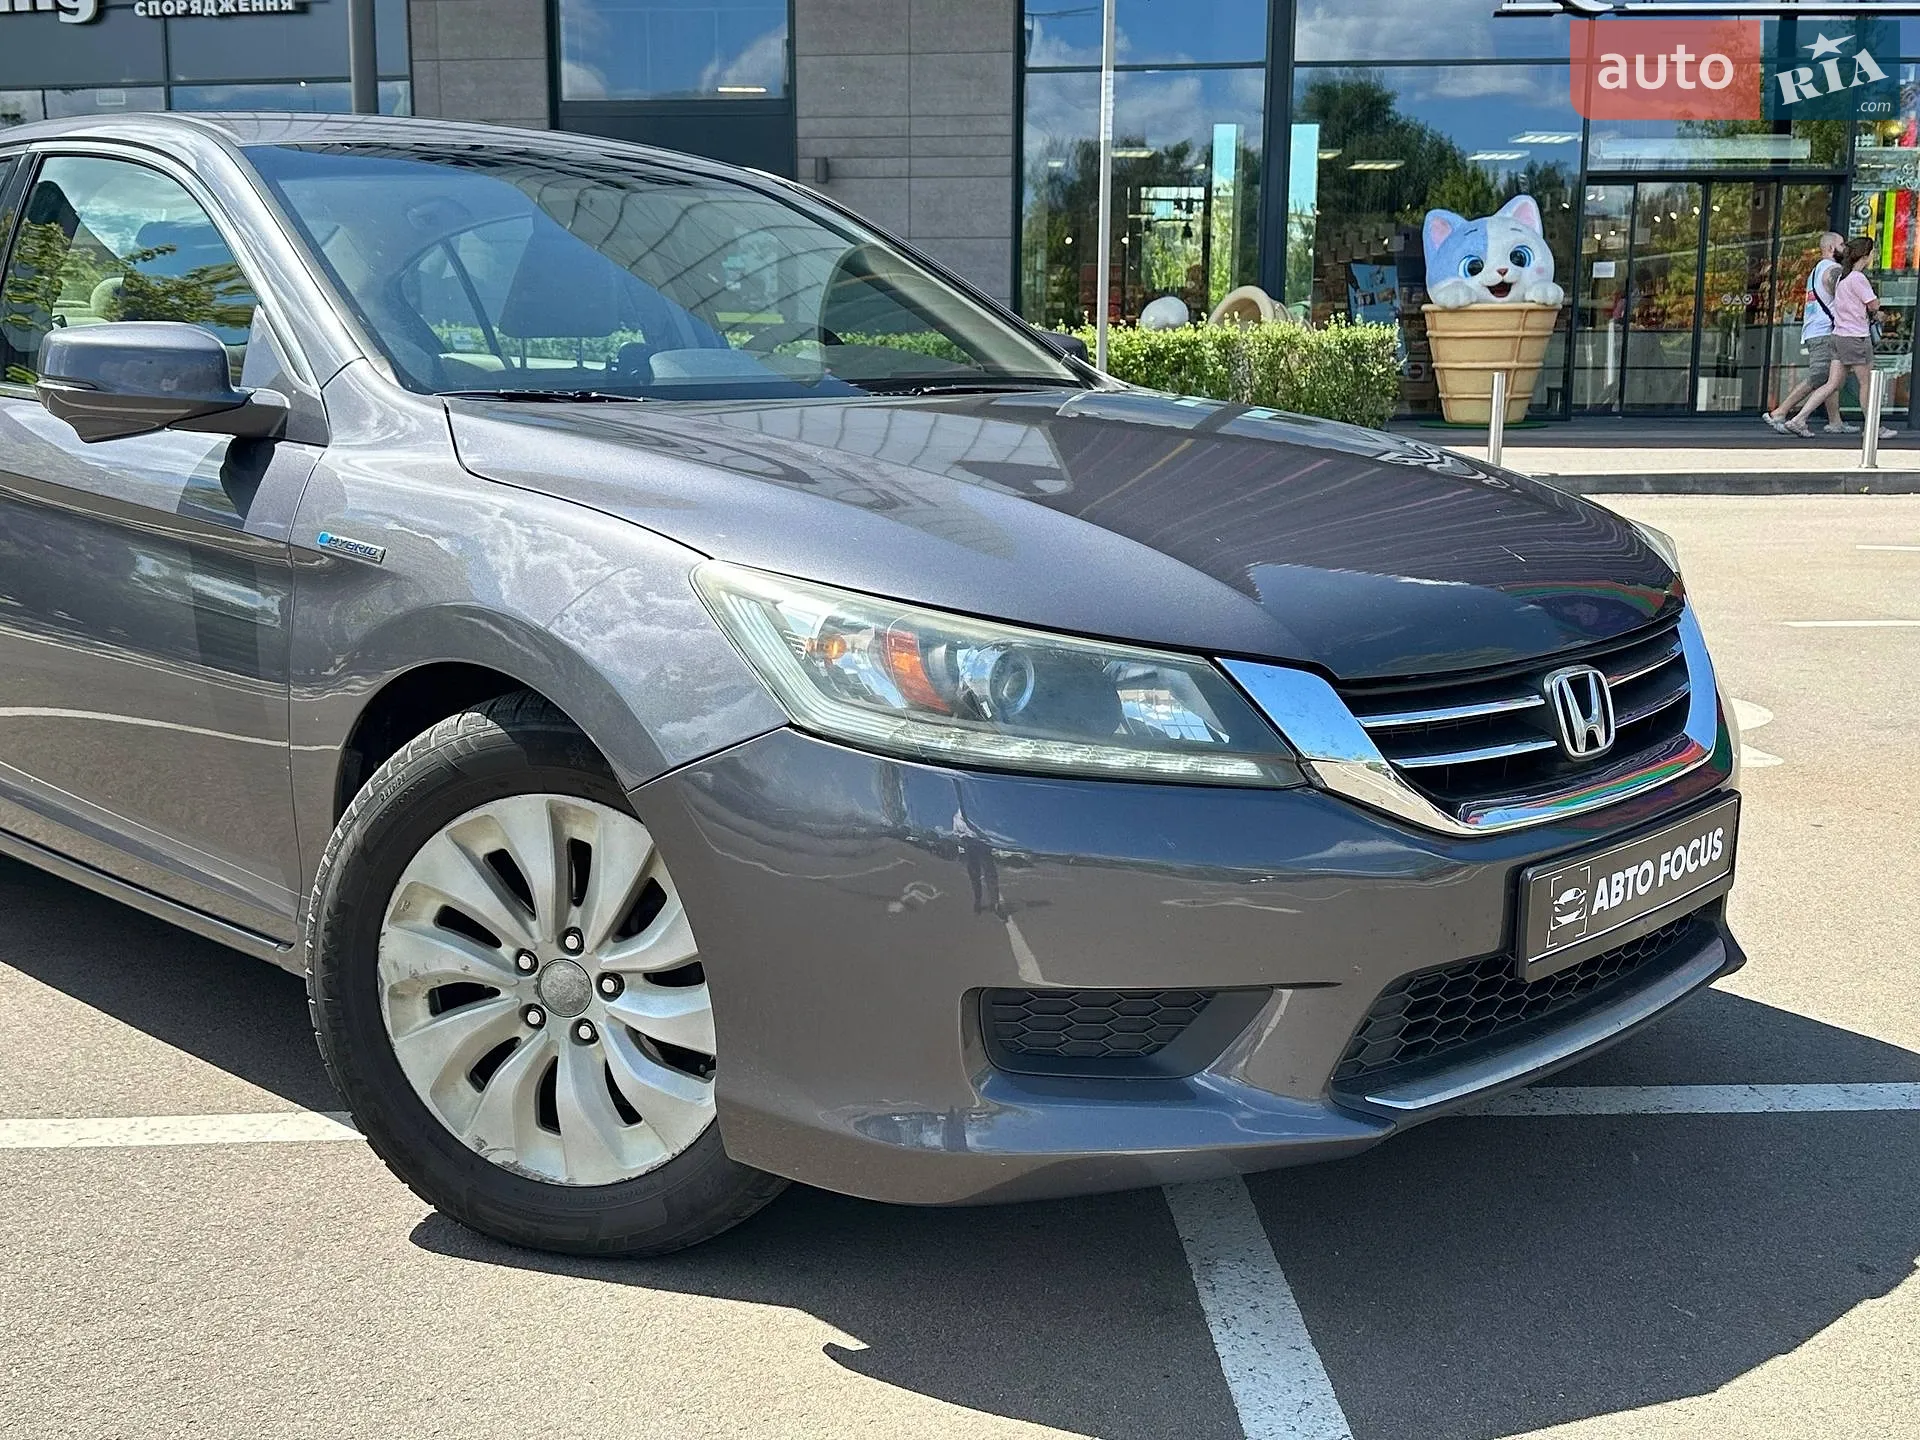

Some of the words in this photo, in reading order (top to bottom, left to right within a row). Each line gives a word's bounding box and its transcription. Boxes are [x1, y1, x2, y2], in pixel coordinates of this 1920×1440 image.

[134, 0, 295, 16] СПОРЯДЖЕННЯ
[327, 536, 378, 555] HYBRID
[1591, 859, 1655, 916] АВТО
[1657, 827, 1724, 887] FOCUS
